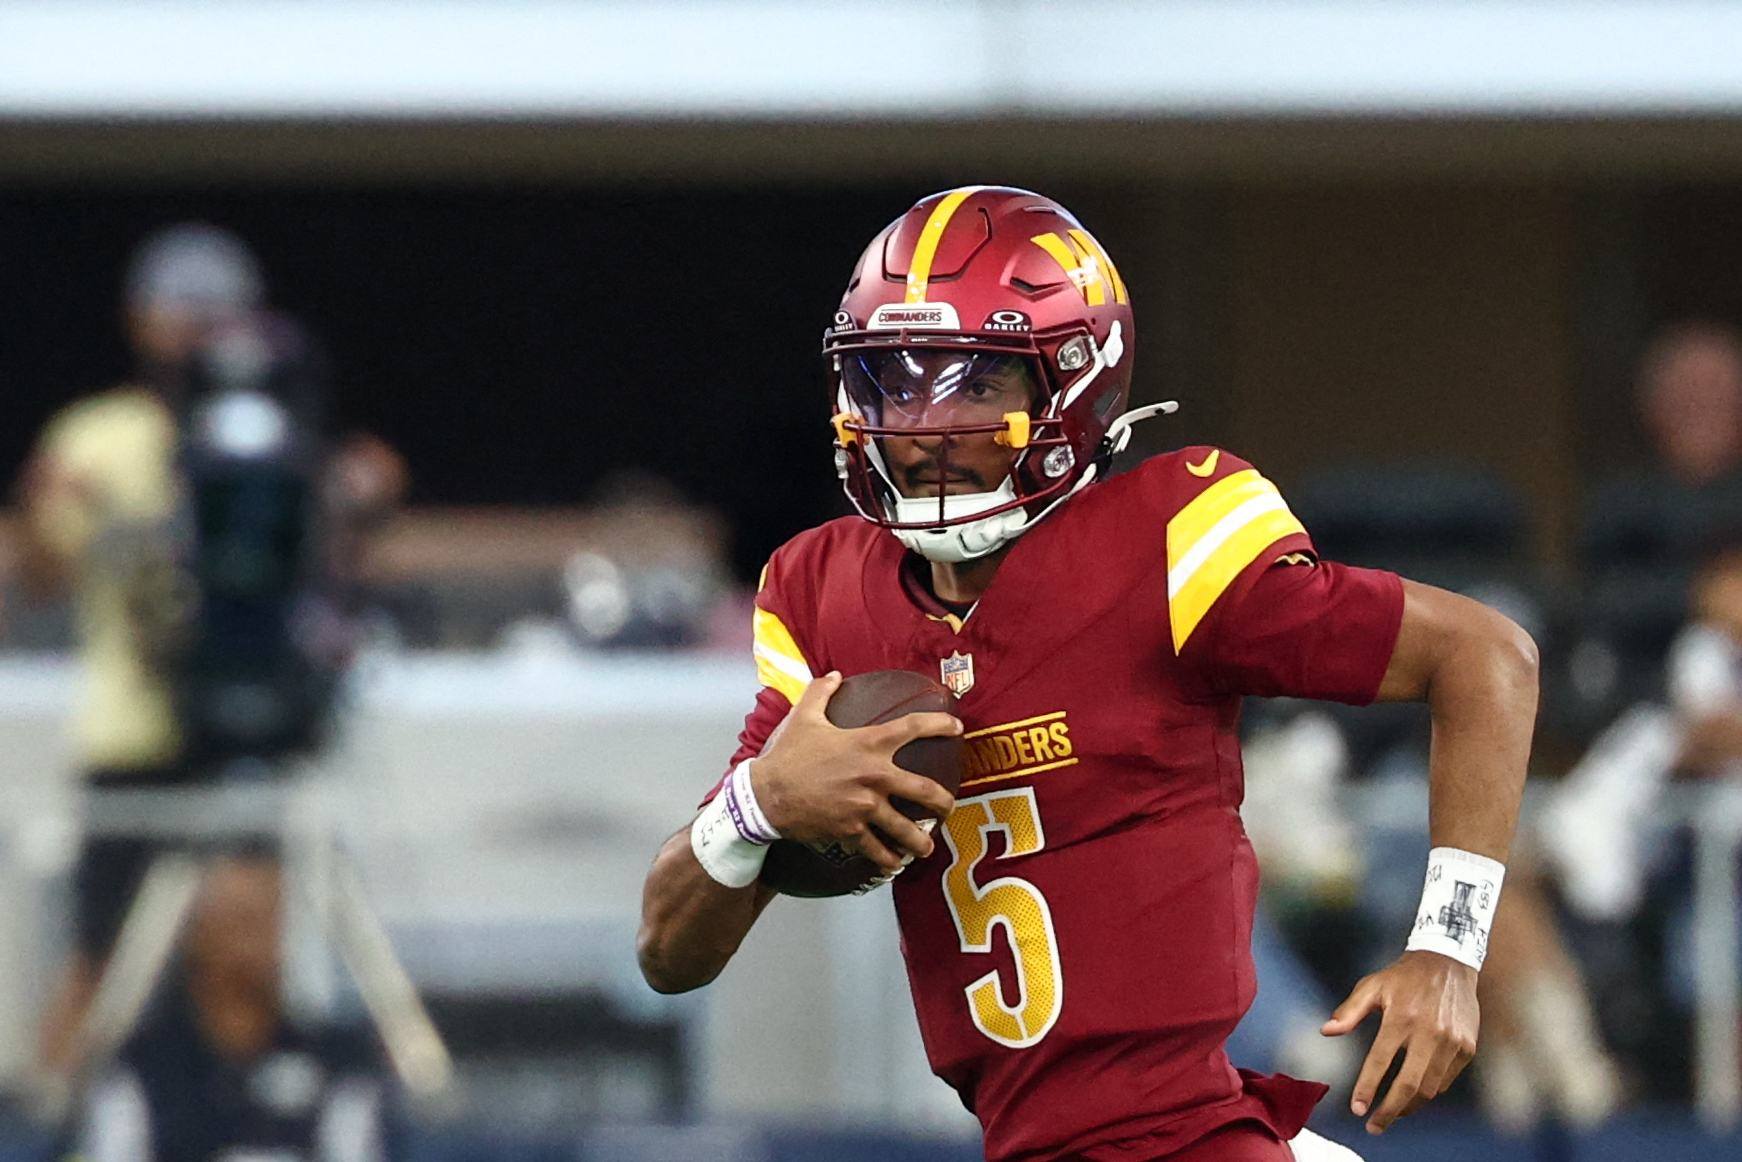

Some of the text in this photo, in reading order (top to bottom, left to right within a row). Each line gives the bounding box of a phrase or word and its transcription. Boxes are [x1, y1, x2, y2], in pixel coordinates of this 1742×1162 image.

[984, 323, 1030, 332] OAKLEY
[960, 721, 1073, 779] ANDERS
[941, 785, 1064, 1050] 5
